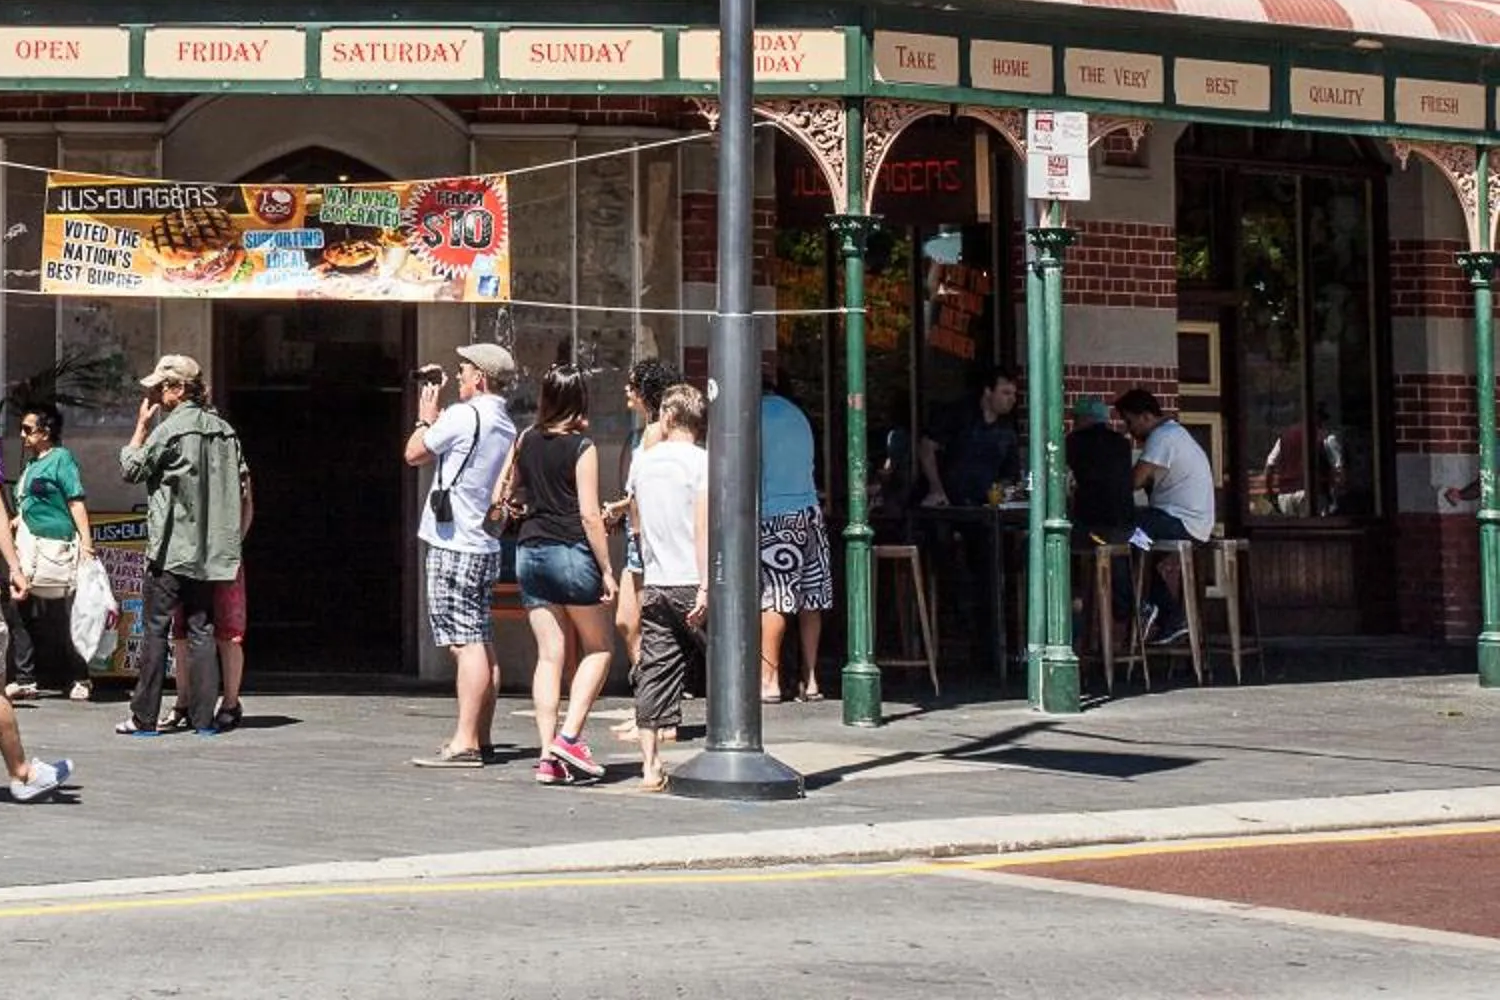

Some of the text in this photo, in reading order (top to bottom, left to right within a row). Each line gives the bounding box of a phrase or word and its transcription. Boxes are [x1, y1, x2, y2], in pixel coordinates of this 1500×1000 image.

[16, 40, 81, 61] OPEN
[178, 39, 269, 63] FRIDAY
[332, 40, 468, 63] SATURDAY
[530, 39, 632, 63] SUNDAY
[895, 46, 937, 70] TAKE
[993, 57, 1030, 78] HOME
[1078, 65, 1150, 89] THE VERY
[1206, 77, 1239, 96] BEST
[1309, 87, 1365, 107] QUALITY
[1421, 96, 1459, 115] FRESH
[65, 220, 140, 248] VOTED THE
[422, 209, 493, 248] $10
[63, 243, 132, 268] NATION'S
[47, 262, 81, 280] BEST
